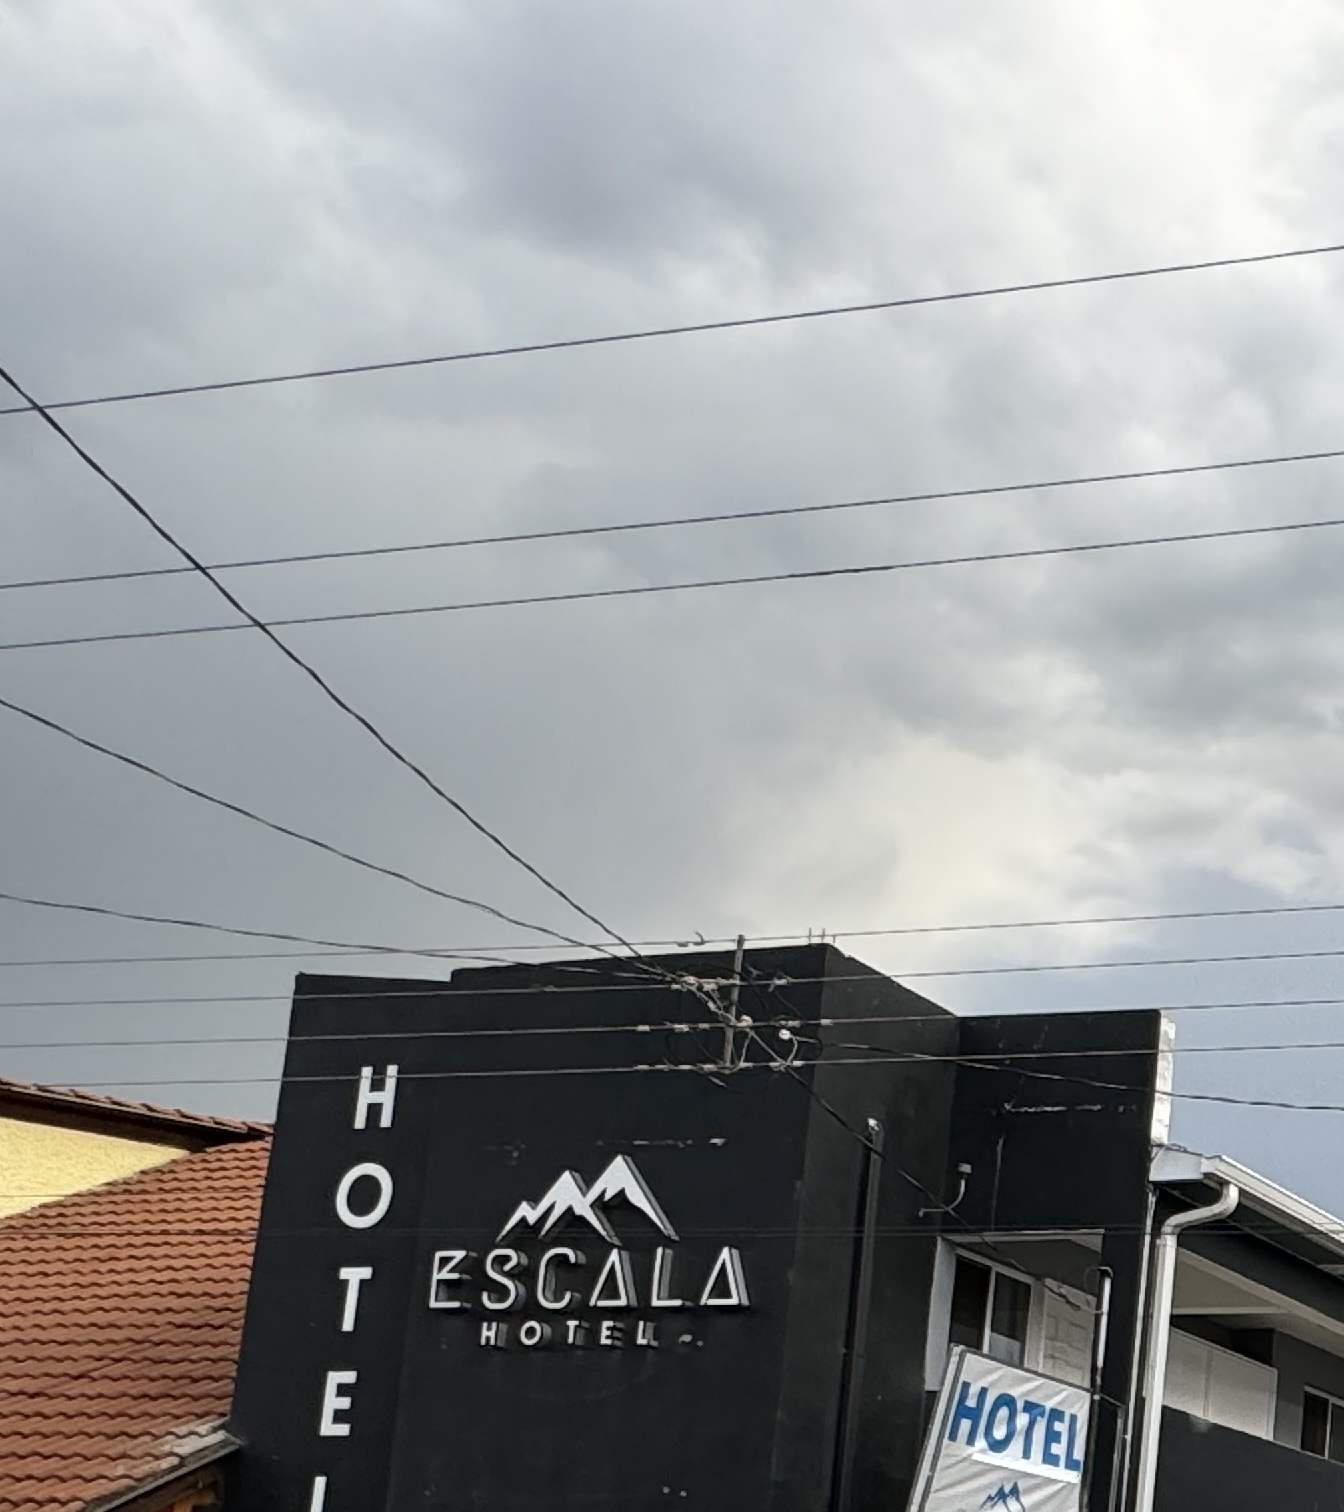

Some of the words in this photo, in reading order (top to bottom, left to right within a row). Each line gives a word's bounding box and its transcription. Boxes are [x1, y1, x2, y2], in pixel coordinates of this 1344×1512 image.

[429, 1246, 749, 1309] ESCALA
[480, 1320, 657, 1347] HOTEL
[948, 1380, 1082, 1472] HOTEL
